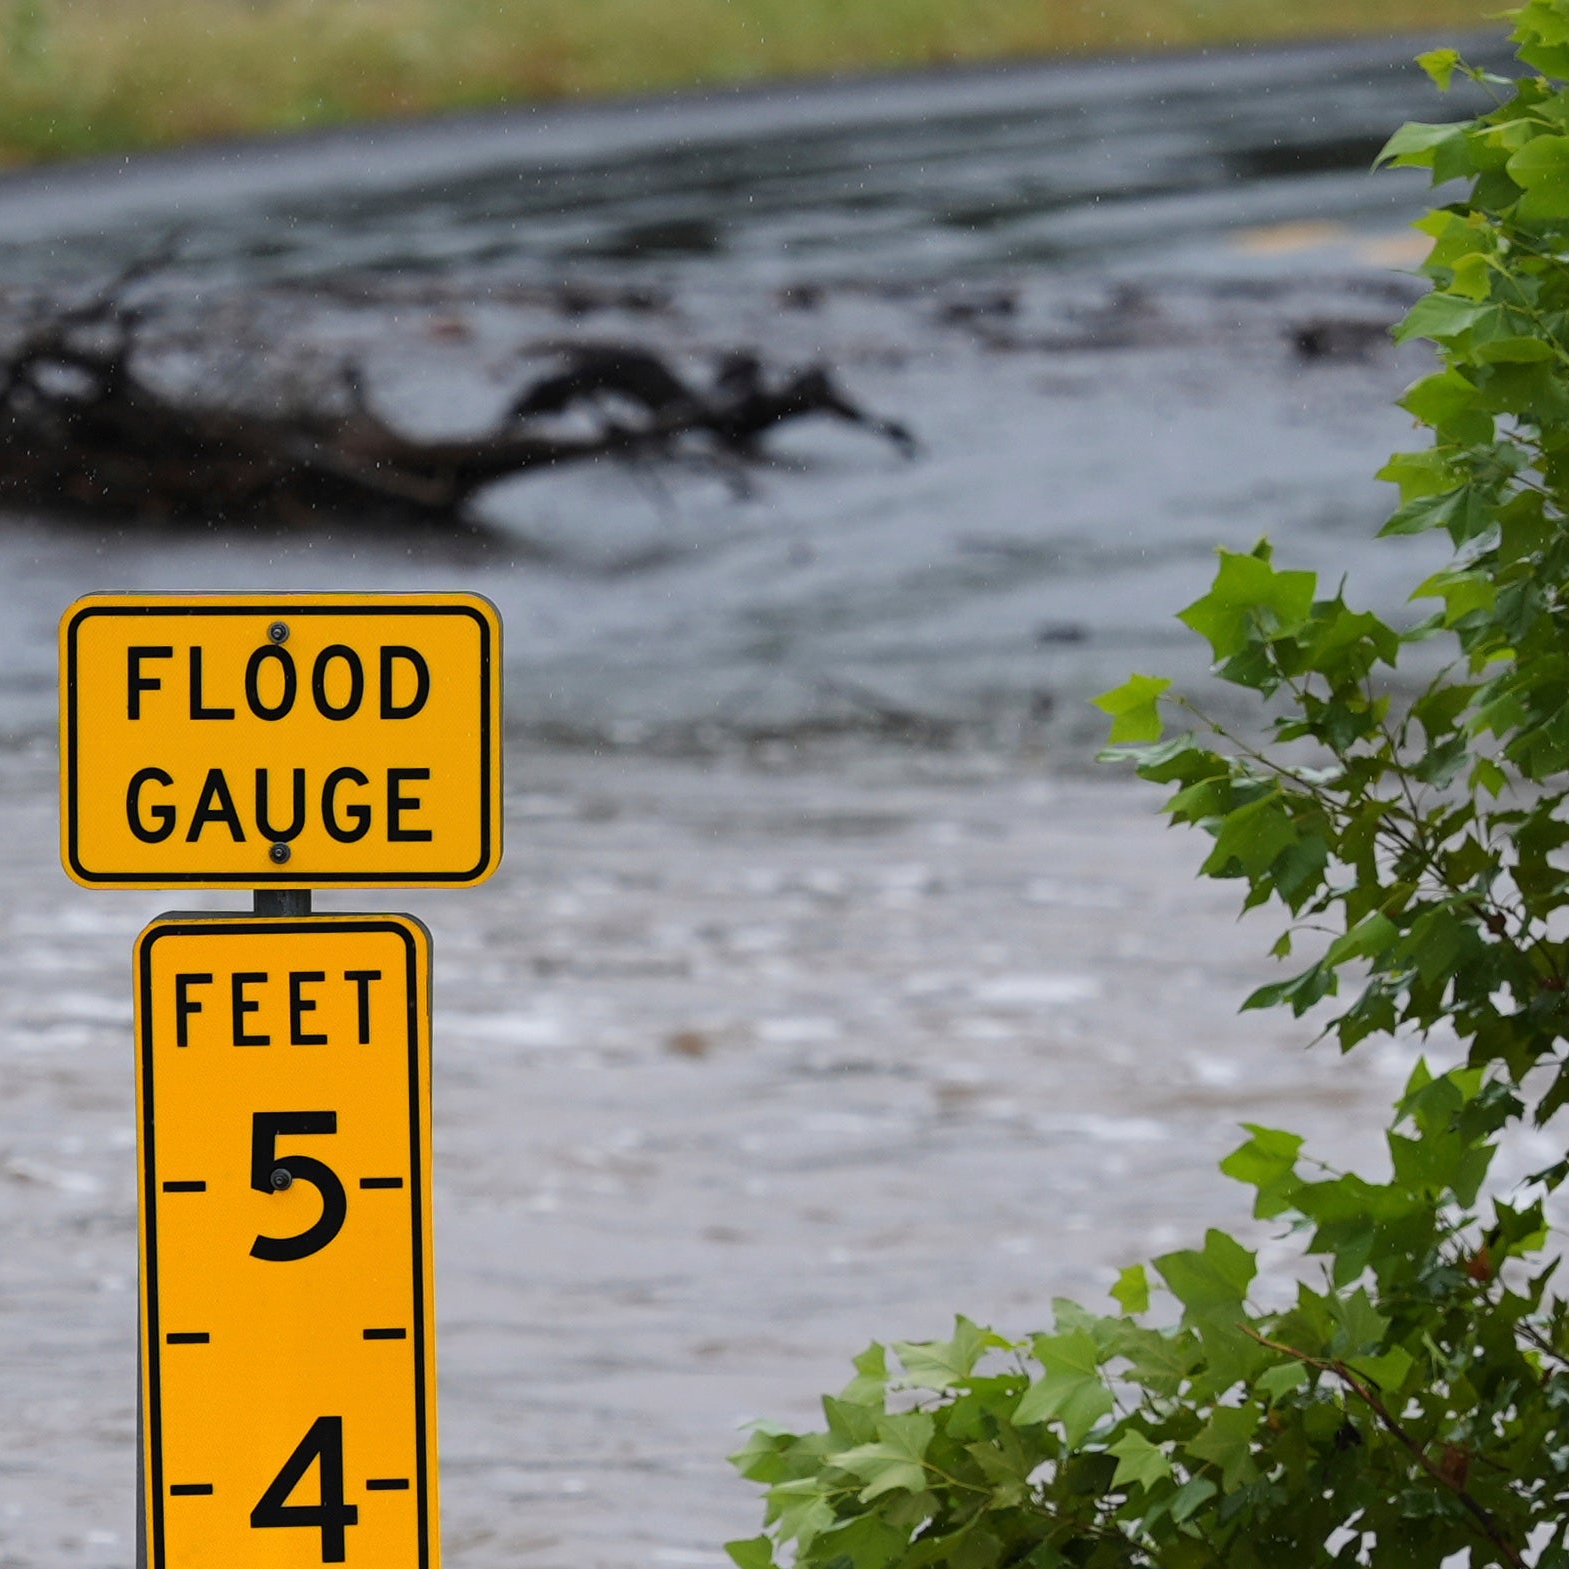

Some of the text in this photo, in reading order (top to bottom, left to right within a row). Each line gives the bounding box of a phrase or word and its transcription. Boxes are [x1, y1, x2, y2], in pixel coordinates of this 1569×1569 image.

[127, 644, 430, 721] FLOOD
[126, 767, 433, 843] GAUGE
[175, 970, 382, 1047] FEET
[249, 1111, 348, 1262] 5
[250, 1416, 358, 1563] 4
